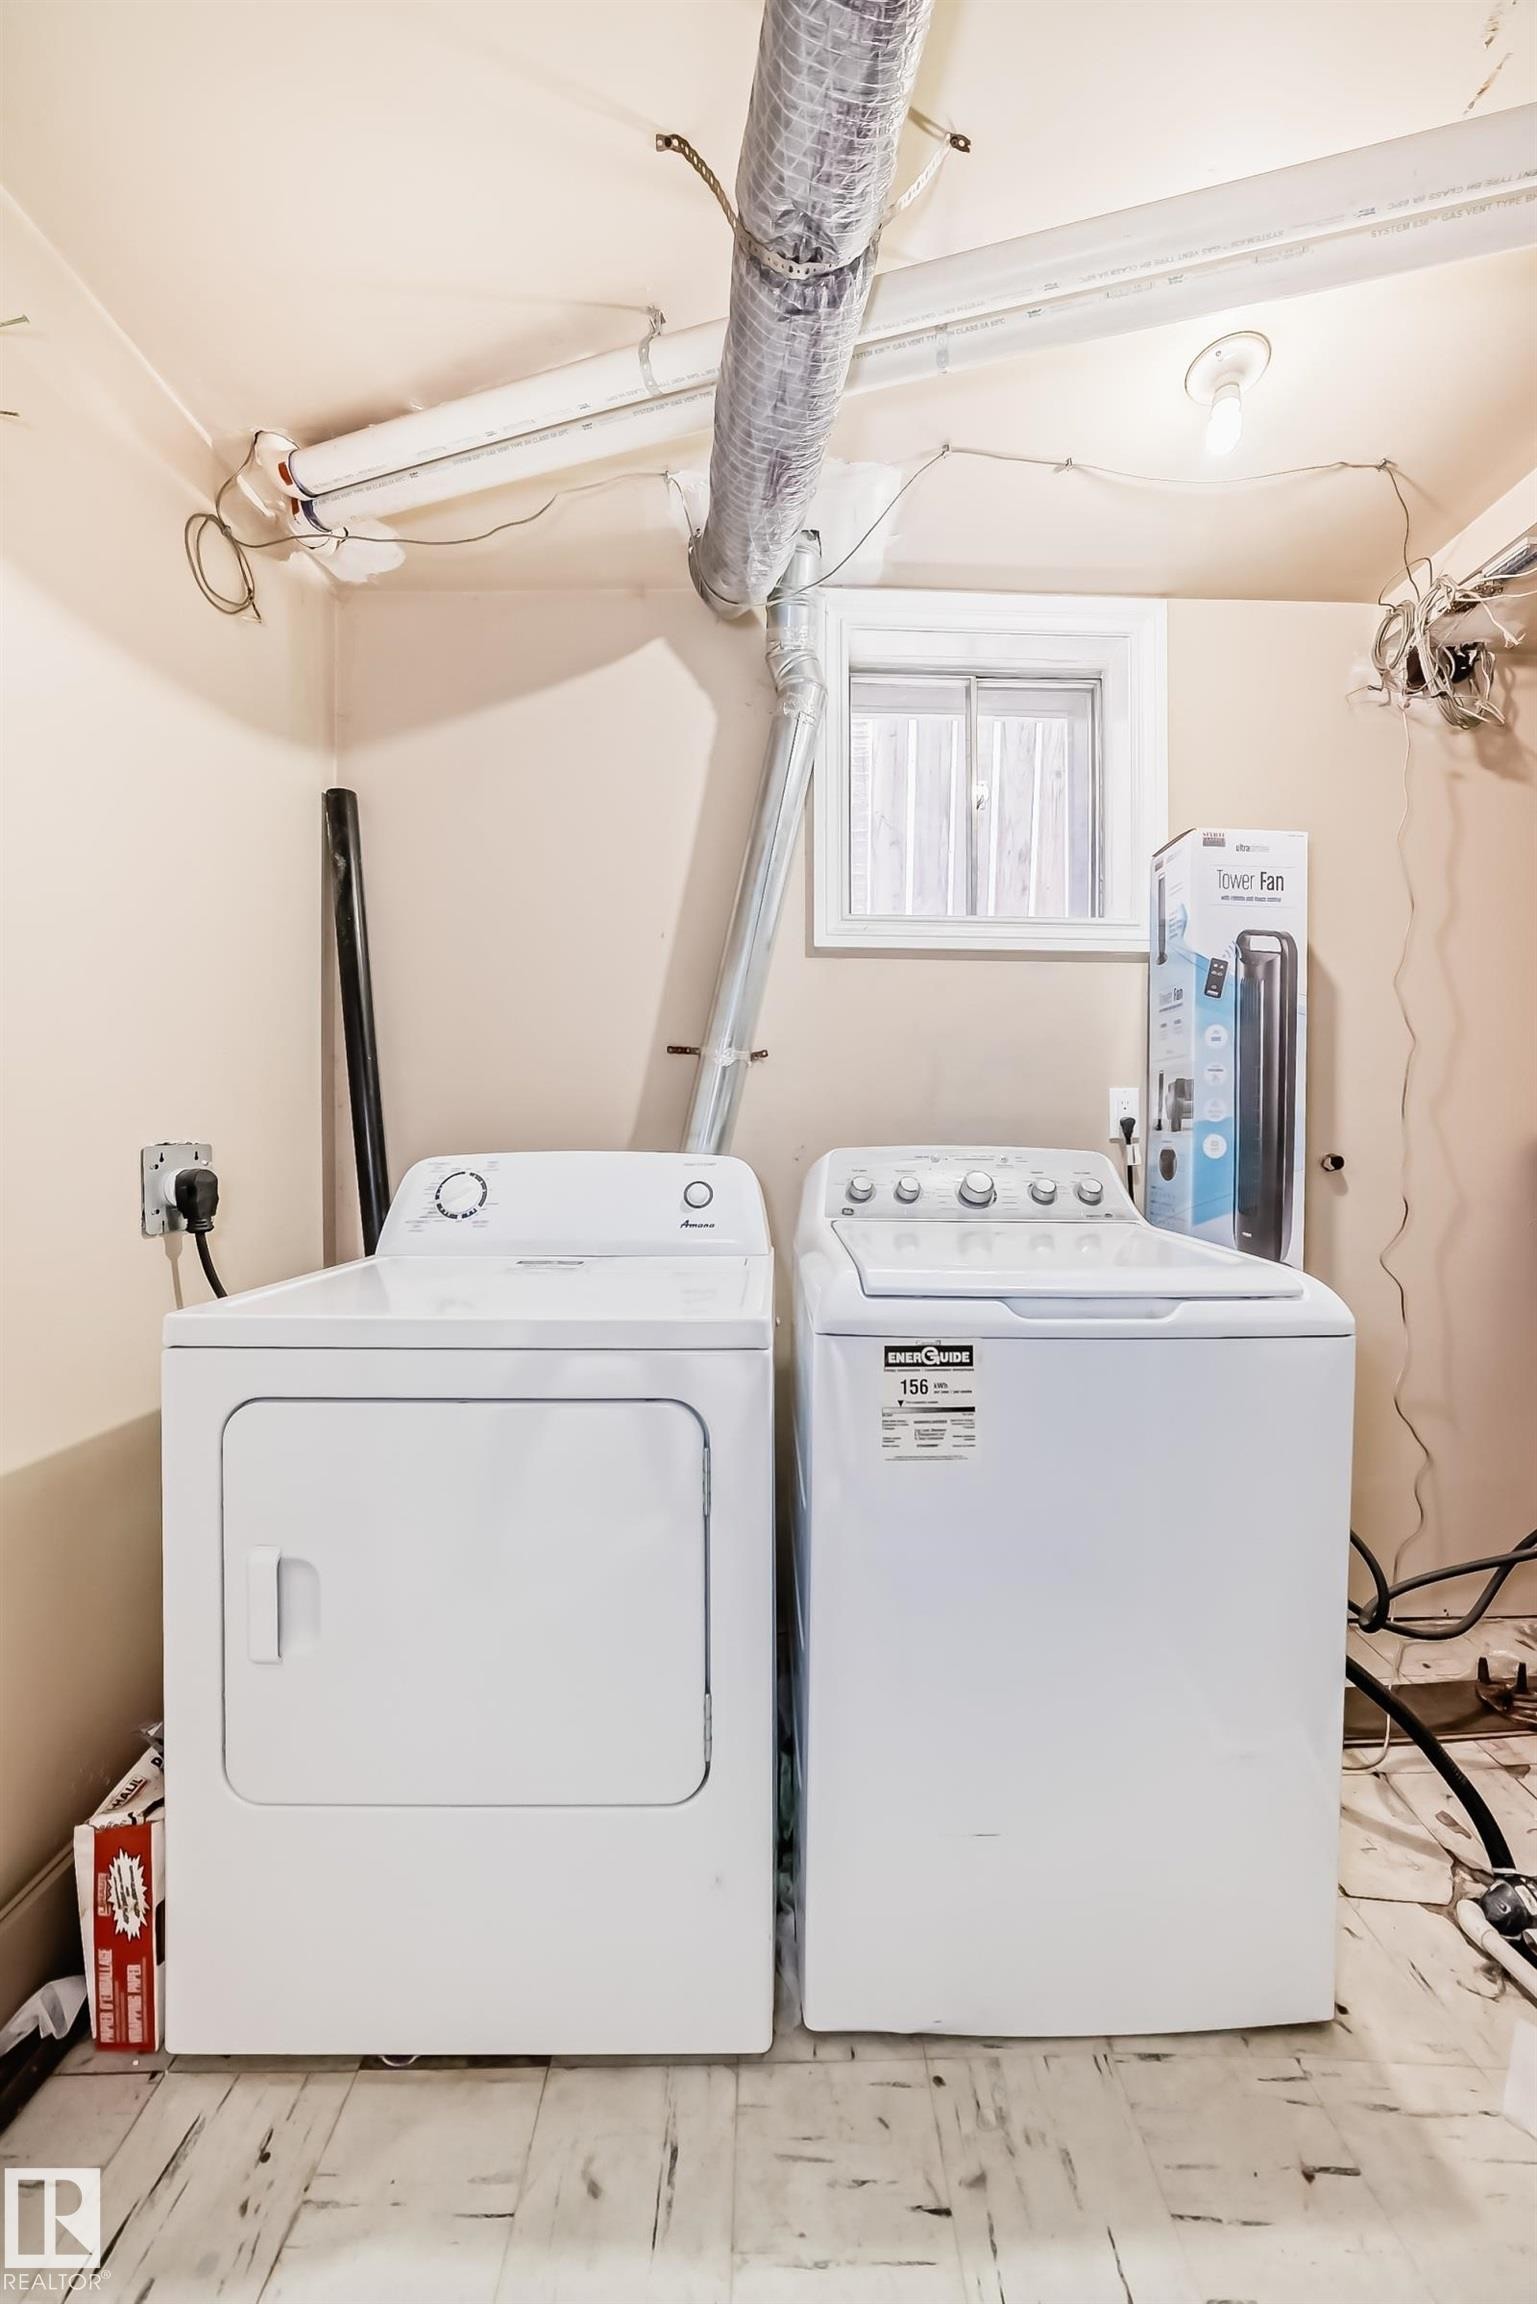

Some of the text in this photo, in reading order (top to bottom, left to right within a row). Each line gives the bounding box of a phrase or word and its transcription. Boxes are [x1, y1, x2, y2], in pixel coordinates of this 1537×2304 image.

[1217, 868, 1284, 891] Tower Fan
[680, 1220, 715, 1229] Amana
[888, 1346, 971, 1366] ENERGUIDE
[900, 1378, 949, 1395] 156 kWh
